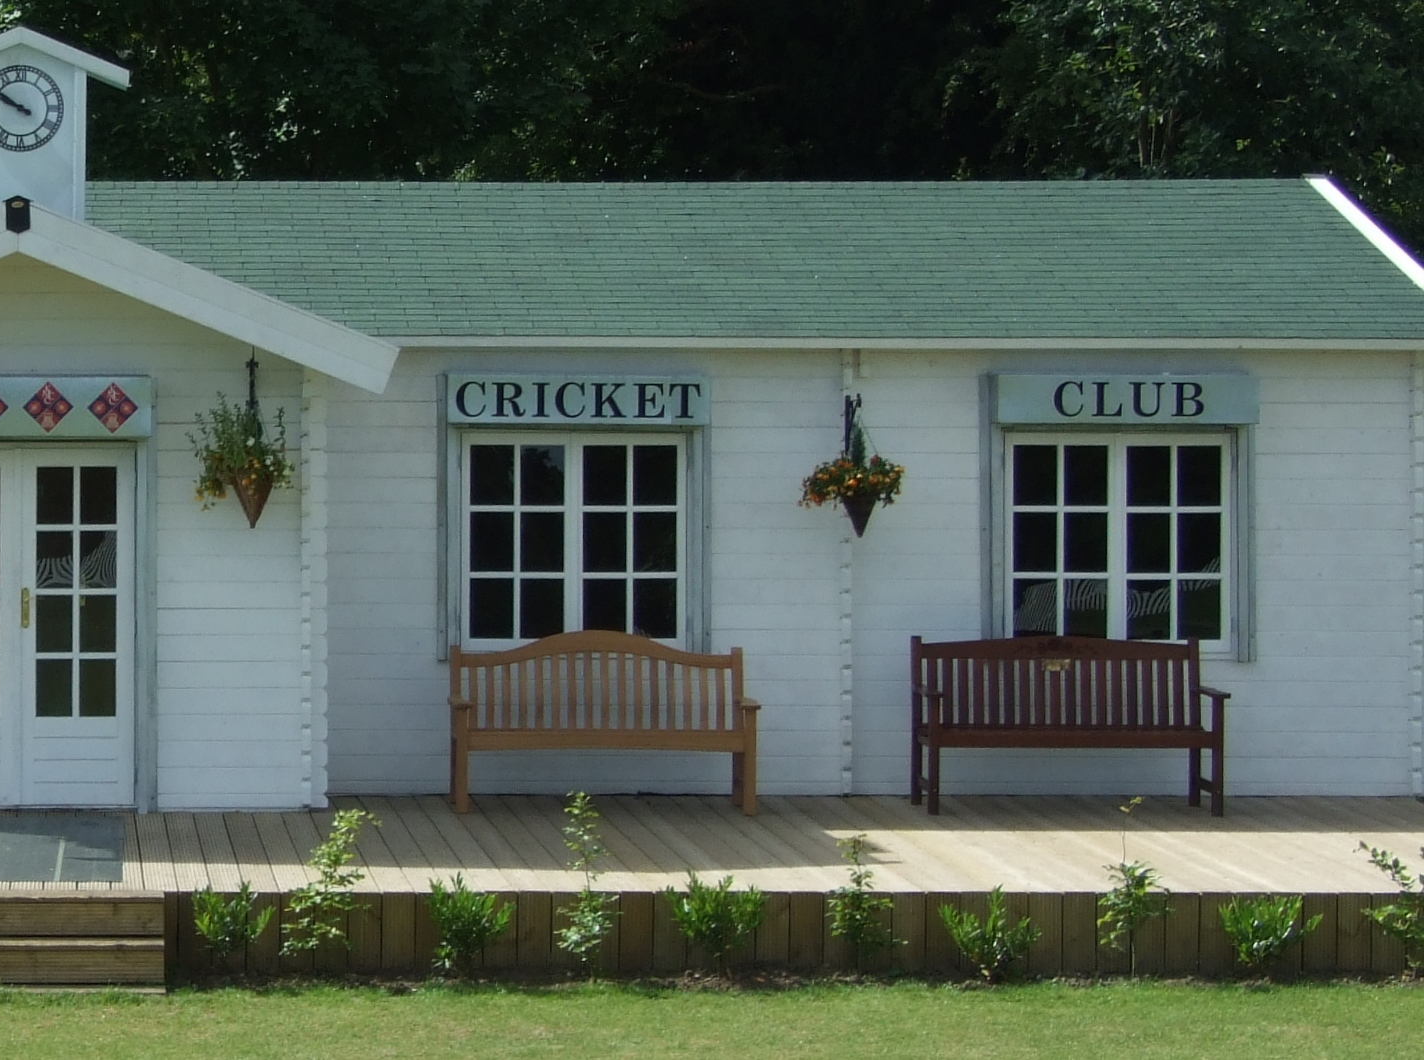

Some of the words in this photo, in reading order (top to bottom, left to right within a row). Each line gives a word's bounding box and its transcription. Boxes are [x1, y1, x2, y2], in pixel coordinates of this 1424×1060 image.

[16, 70, 27, 82] XII
[455, 380, 702, 419] CRICKET
[1053, 380, 1205, 418] CLUB
